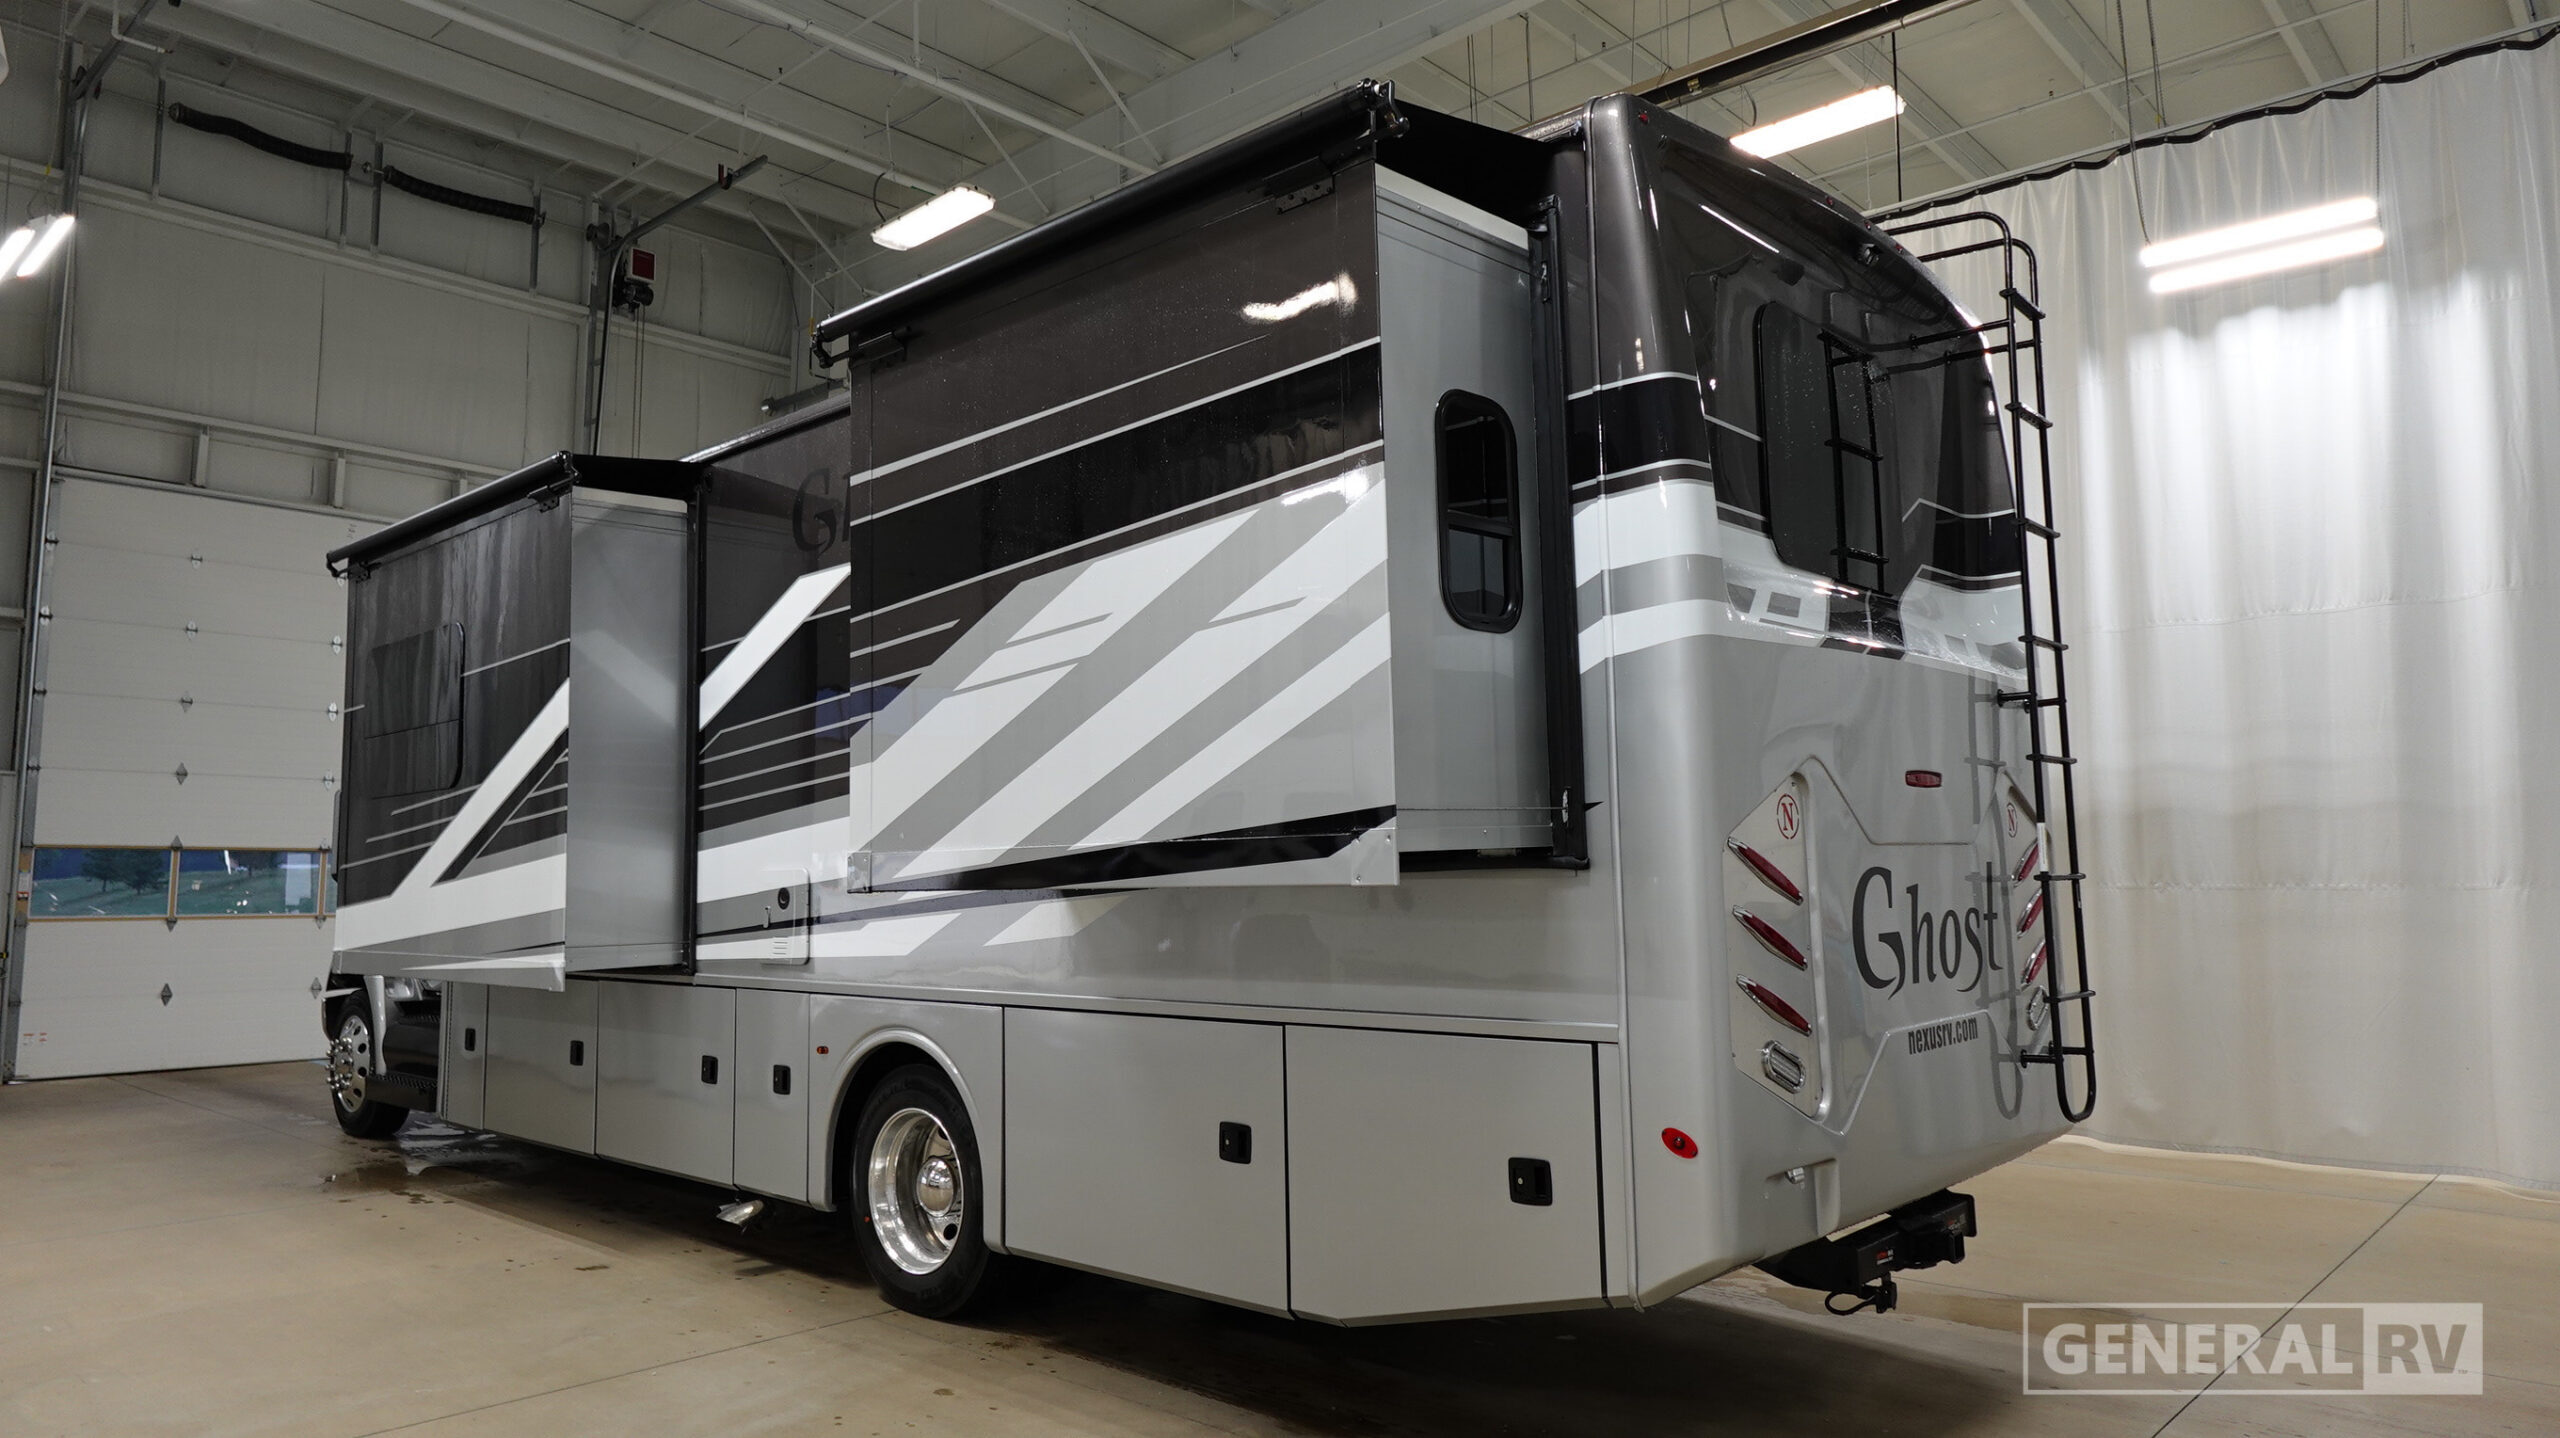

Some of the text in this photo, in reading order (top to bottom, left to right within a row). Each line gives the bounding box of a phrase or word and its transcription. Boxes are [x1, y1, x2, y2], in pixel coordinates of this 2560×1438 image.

[792, 468, 851, 560] G
[1852, 861, 2004, 1001] Ghost
[1908, 1017, 1979, 1055] nexusrv.com
